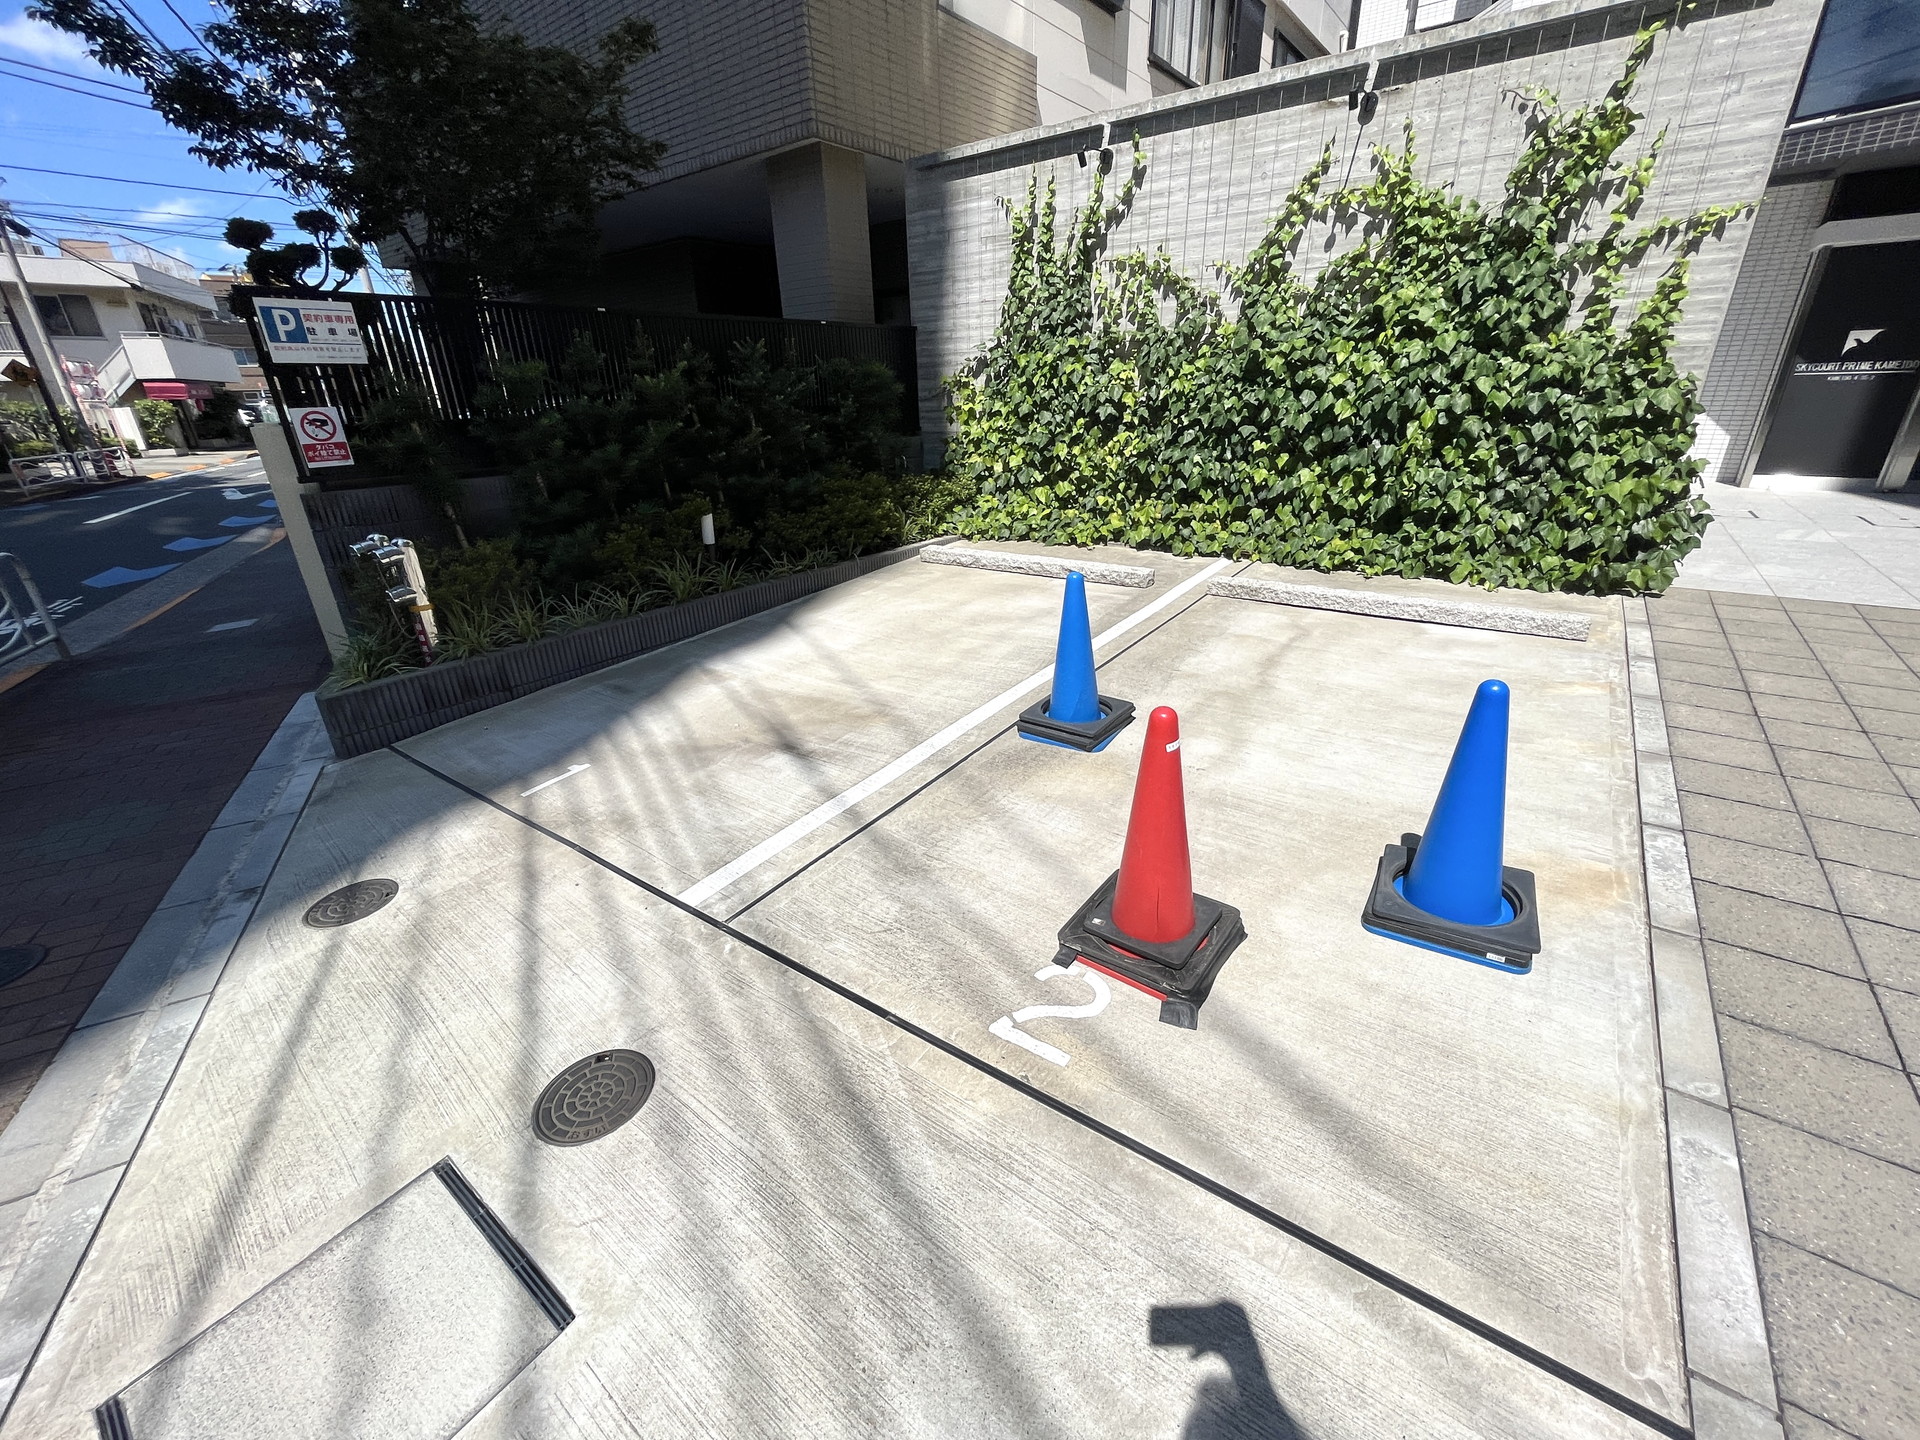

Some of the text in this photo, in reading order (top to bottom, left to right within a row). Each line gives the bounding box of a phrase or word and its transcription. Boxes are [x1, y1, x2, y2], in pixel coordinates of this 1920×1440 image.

[271, 308, 296, 341] P
[302, 313, 355, 325] 契約車専用
[306, 326, 358, 337] 駐車場
[1794, 360, 1920, 372] SKYCOURT PRIME KAMEIDO
[988, 964, 1112, 1067] 2
